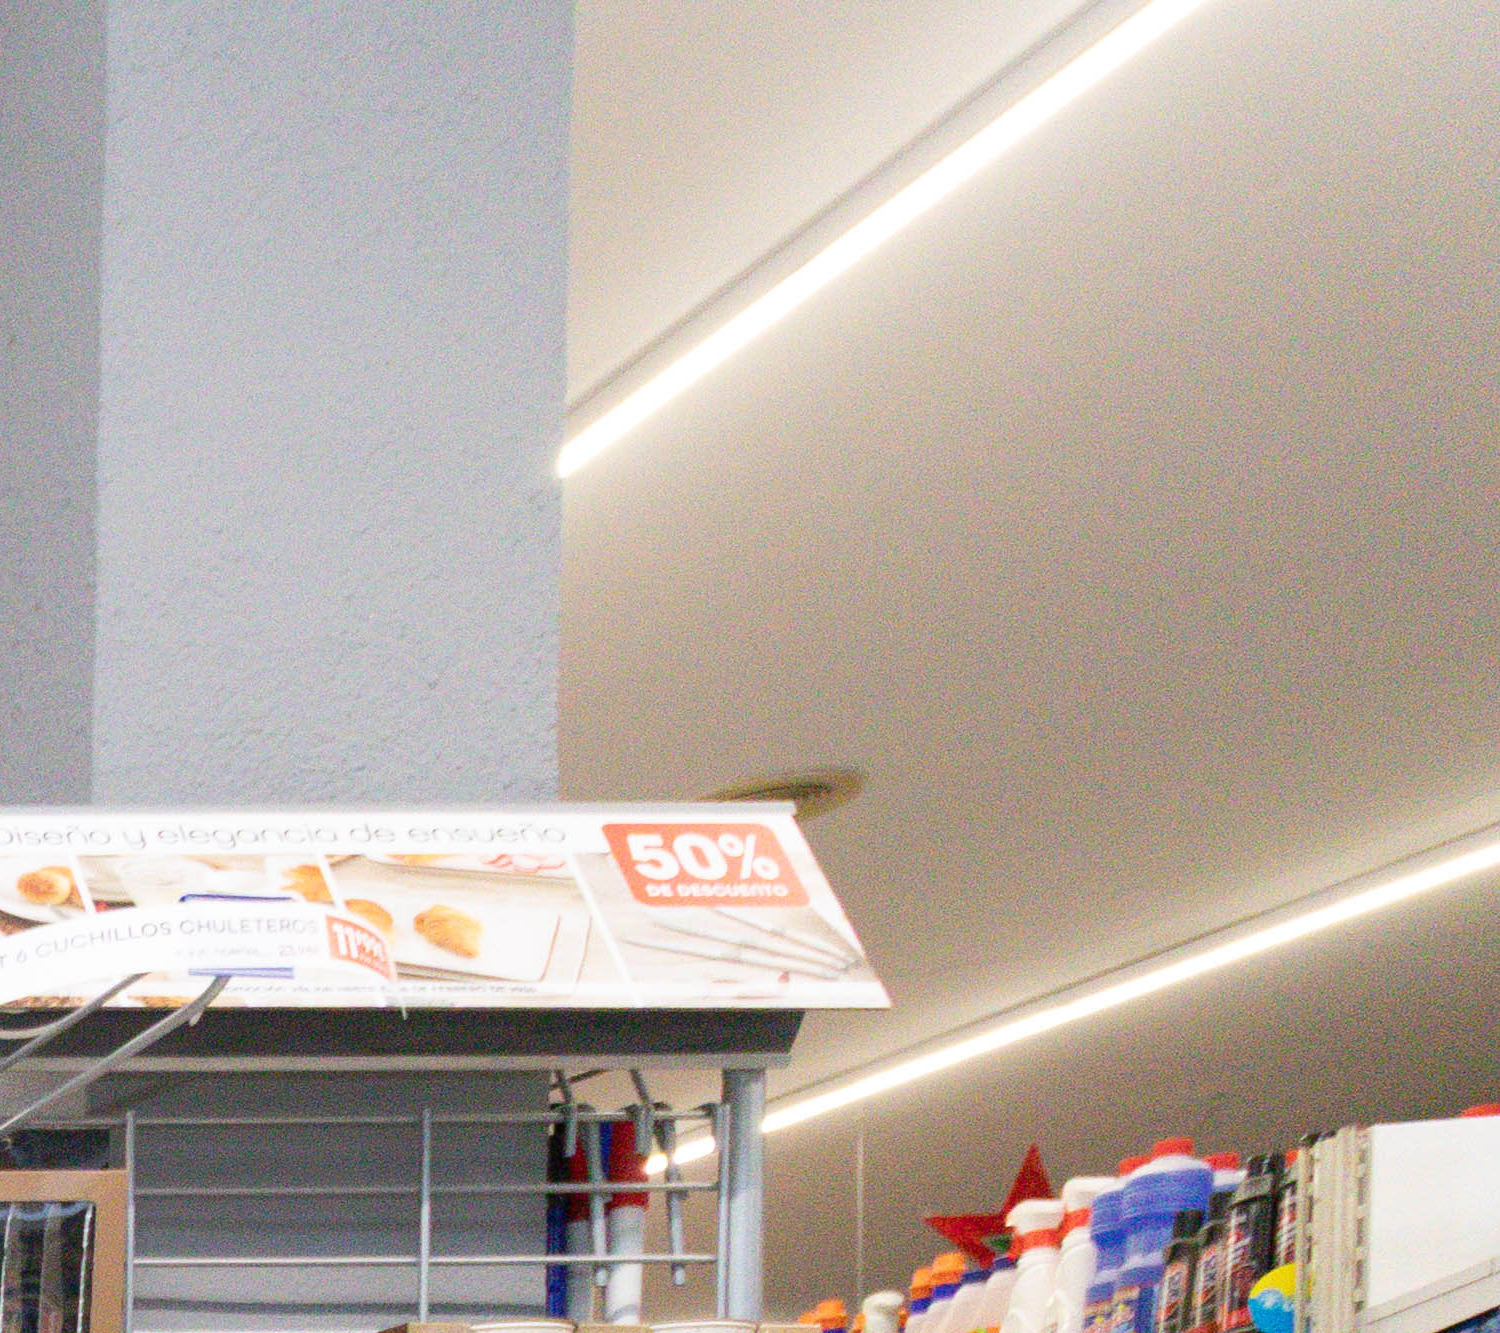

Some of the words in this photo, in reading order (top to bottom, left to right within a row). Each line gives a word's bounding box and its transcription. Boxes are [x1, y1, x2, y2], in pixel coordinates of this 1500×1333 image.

[122, 831, 147, 850] y
[157, 825, 339, 850] elegancia
[349, 825, 396, 845] de
[407, 823, 567, 844] ensueño
[628, 834, 780, 881] 50%
[647, 884, 672, 897] DE
[677, 884, 788, 898] DESCUENTO
[35, 921, 172, 959] CUCHILLOS
[179, 917, 319, 937] CHULETEROS
